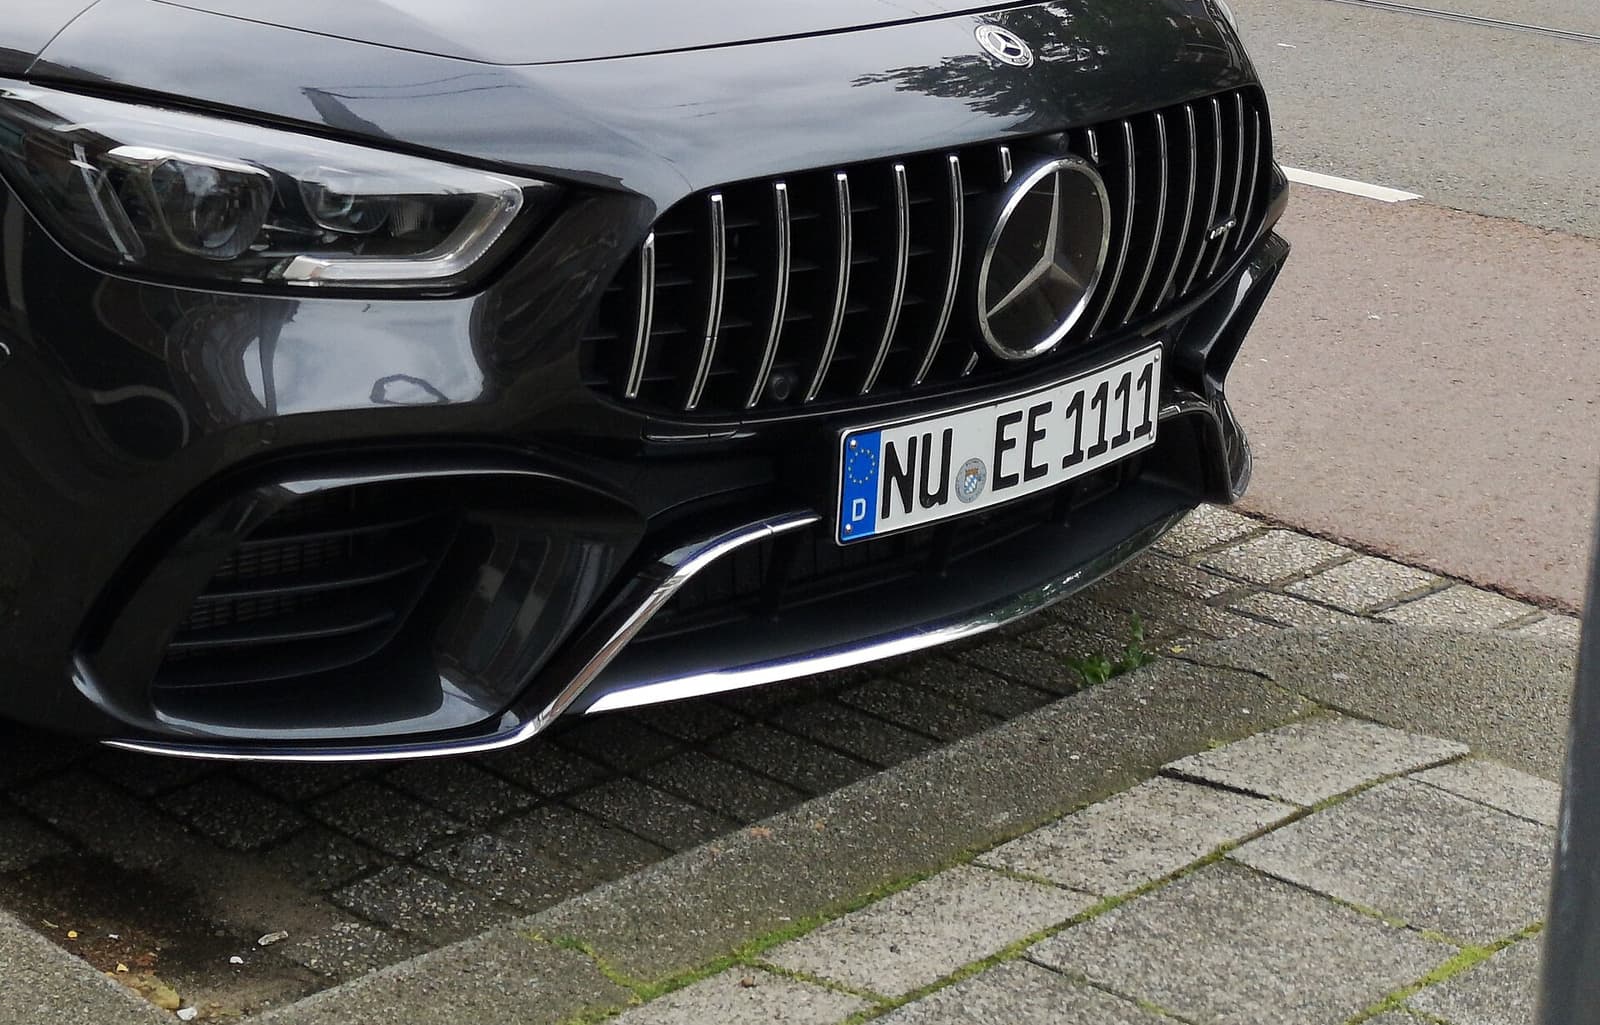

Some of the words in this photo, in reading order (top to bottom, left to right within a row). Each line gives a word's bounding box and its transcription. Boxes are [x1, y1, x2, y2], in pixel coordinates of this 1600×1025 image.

[881, 428, 953, 519] NU
[991, 401, 1053, 492] EE
[1062, 363, 1153, 470] 1111
[852, 498, 866, 522] D
